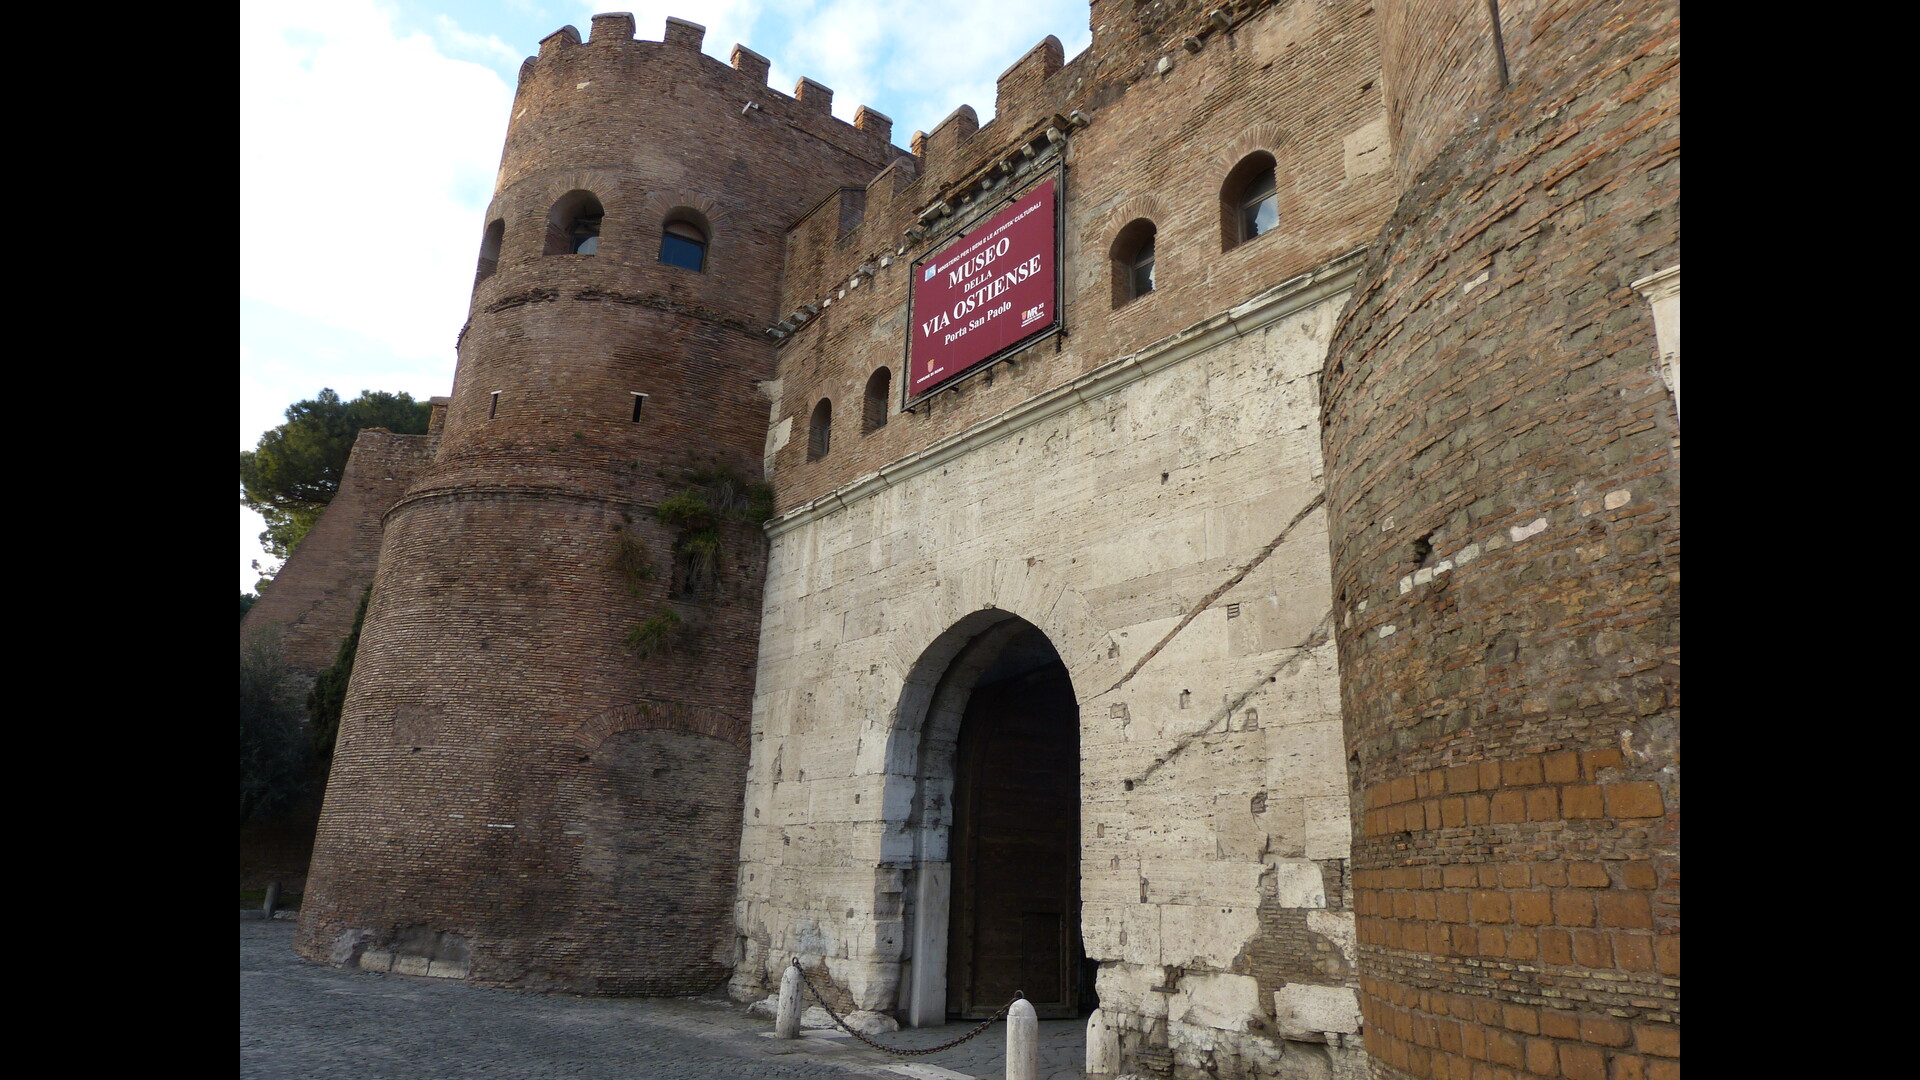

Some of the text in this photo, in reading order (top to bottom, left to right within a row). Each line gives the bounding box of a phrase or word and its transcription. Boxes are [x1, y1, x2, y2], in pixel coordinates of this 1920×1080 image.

[948, 237, 1010, 290] MUSEO
[964, 269, 993, 293] DELLA
[922, 253, 1042, 338] VIA OSTIENSE
[944, 326, 967, 346] Porta
[968, 316, 985, 332] San
[987, 301, 1012, 322] Paolo
